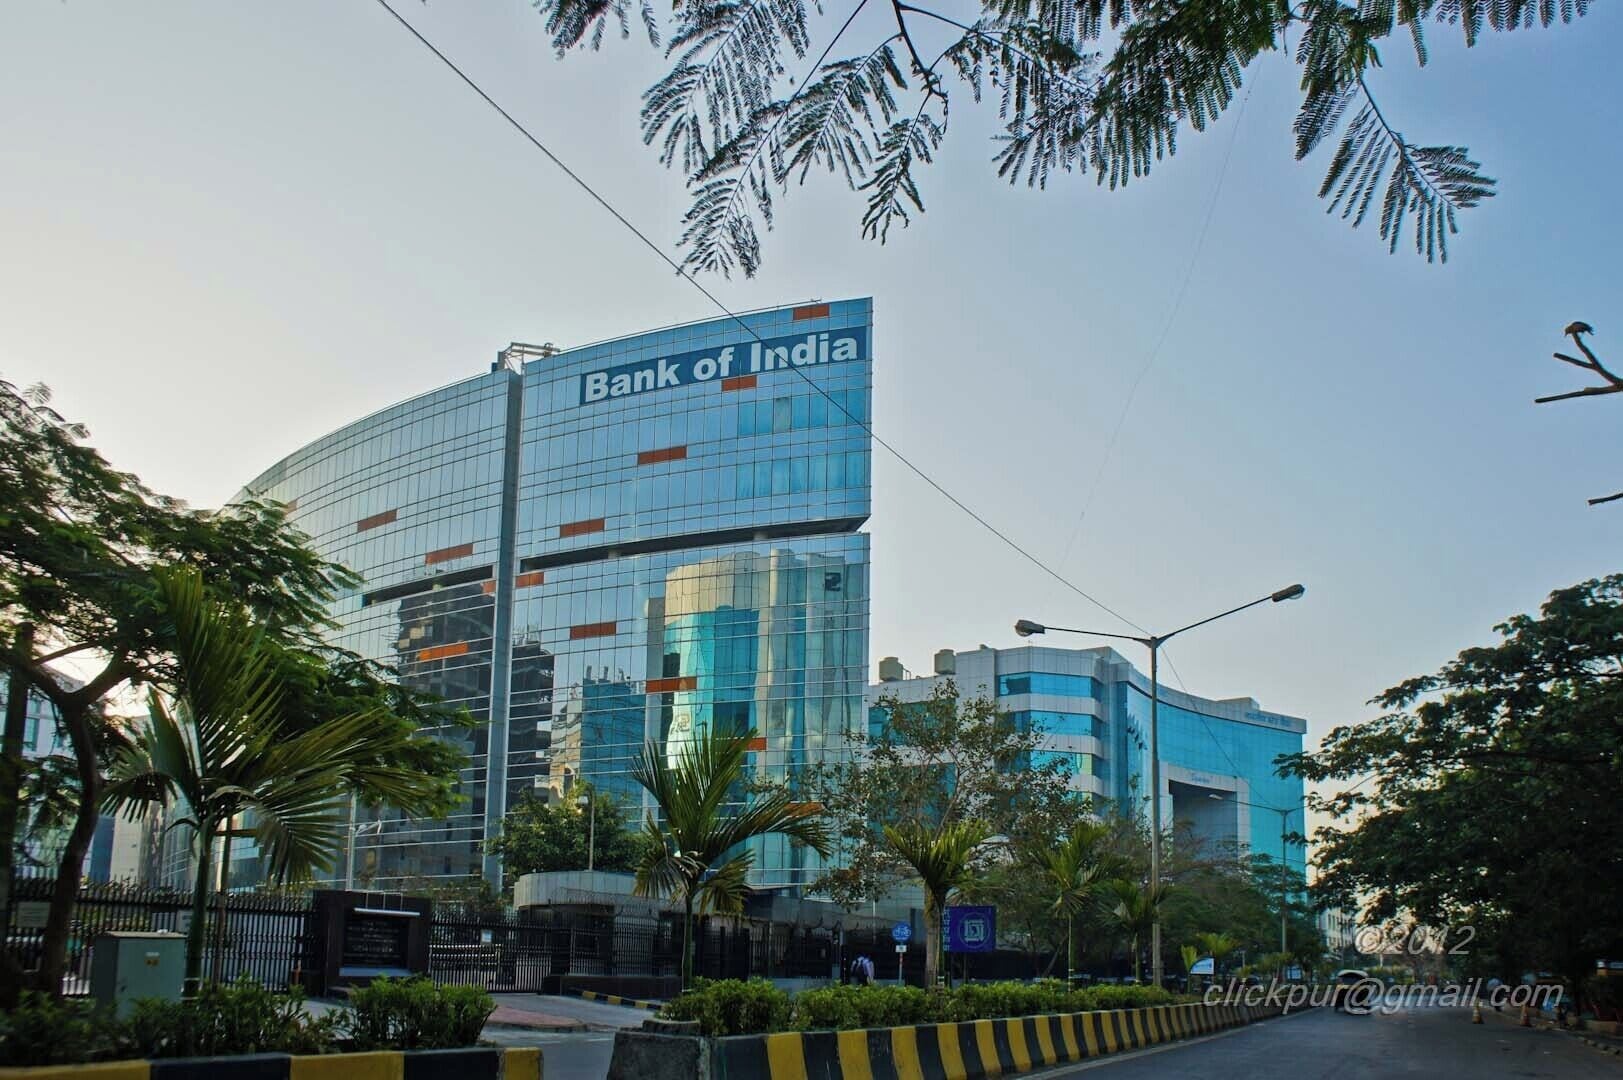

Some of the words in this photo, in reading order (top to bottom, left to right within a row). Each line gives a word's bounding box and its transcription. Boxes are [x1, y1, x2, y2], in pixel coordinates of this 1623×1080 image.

[585, 358, 680, 402] Bank
[693, 347, 735, 381] of
[751, 333, 858, 373] India
